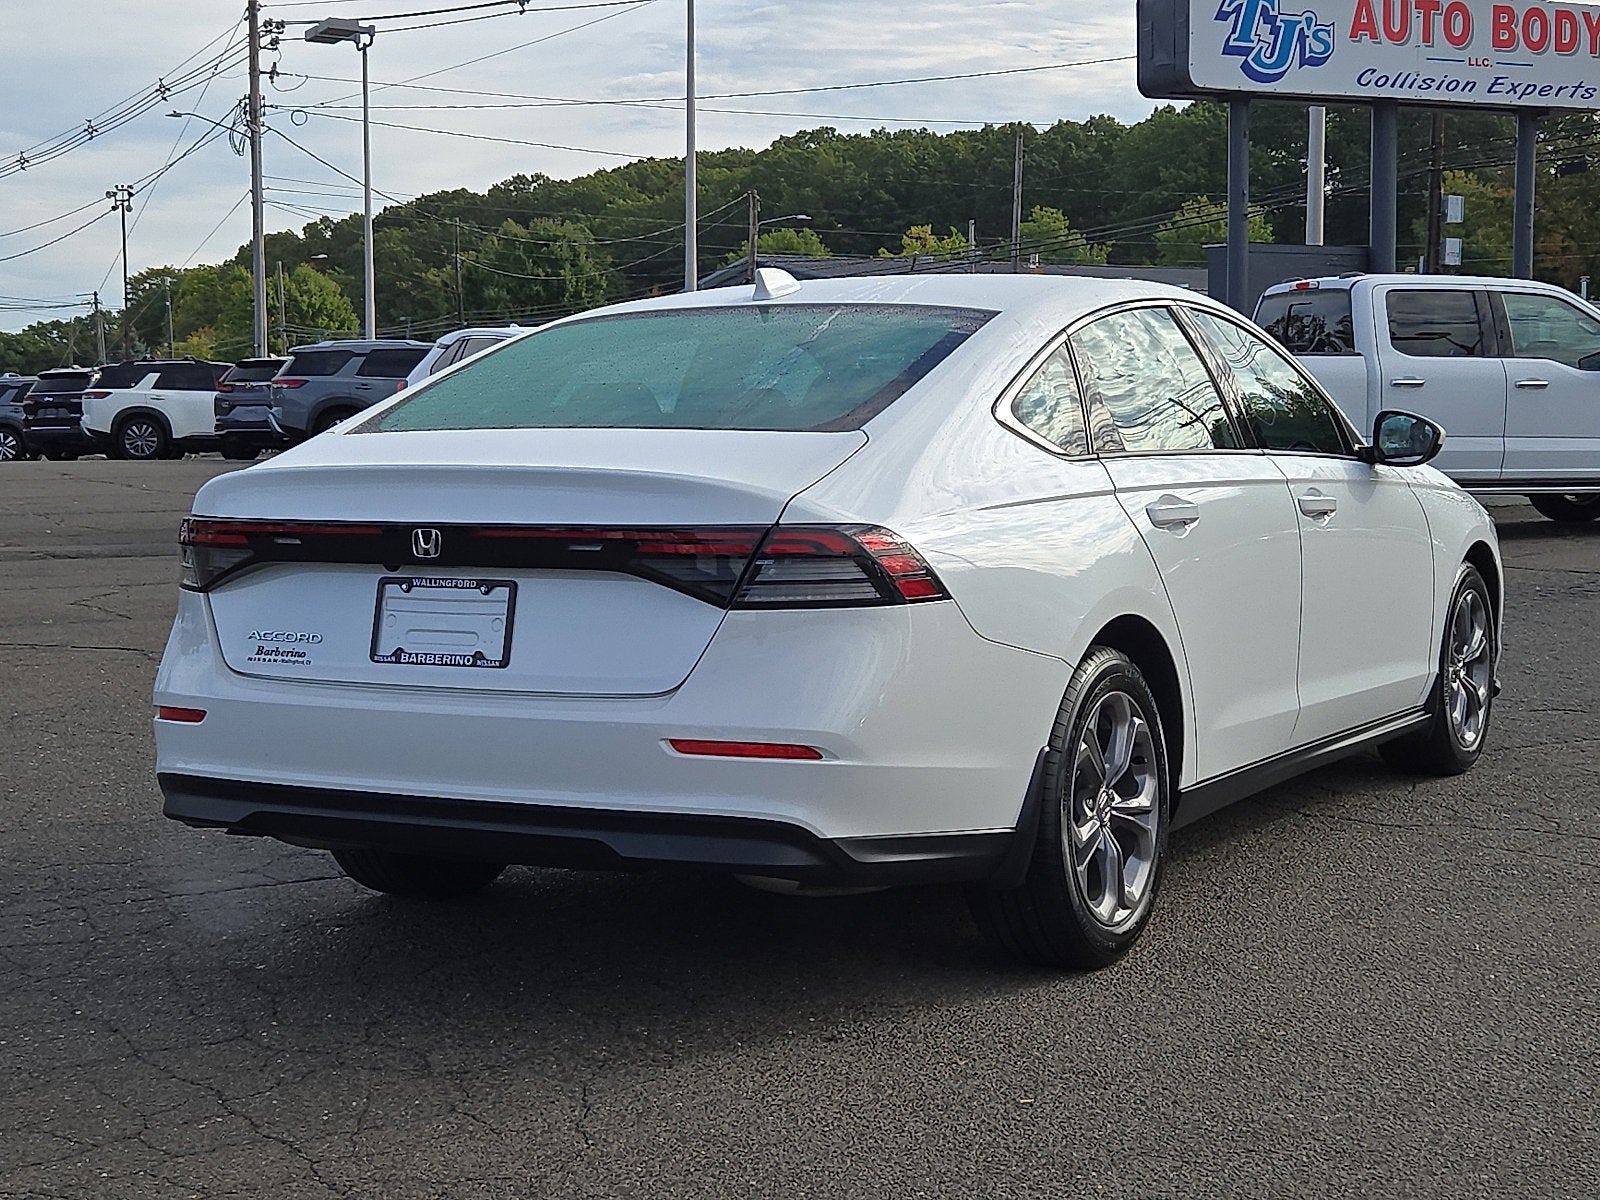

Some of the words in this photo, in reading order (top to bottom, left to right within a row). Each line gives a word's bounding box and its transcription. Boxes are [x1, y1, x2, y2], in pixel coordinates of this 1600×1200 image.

[1349, 0, 1473, 49] AUTO
[1491, 4, 1600, 57] BODY
[1214, 0, 1335, 84] TJ's
[1467, 56, 1493, 68] LLC.
[1356, 67, 1477, 93] Collision
[1486, 76, 1598, 100] Experts
[412, 578, 477, 588] WALLINGFORD
[247, 630, 323, 644] ACCORD
[255, 645, 307, 659] Barberino
[401, 652, 473, 666] BARBERINO
